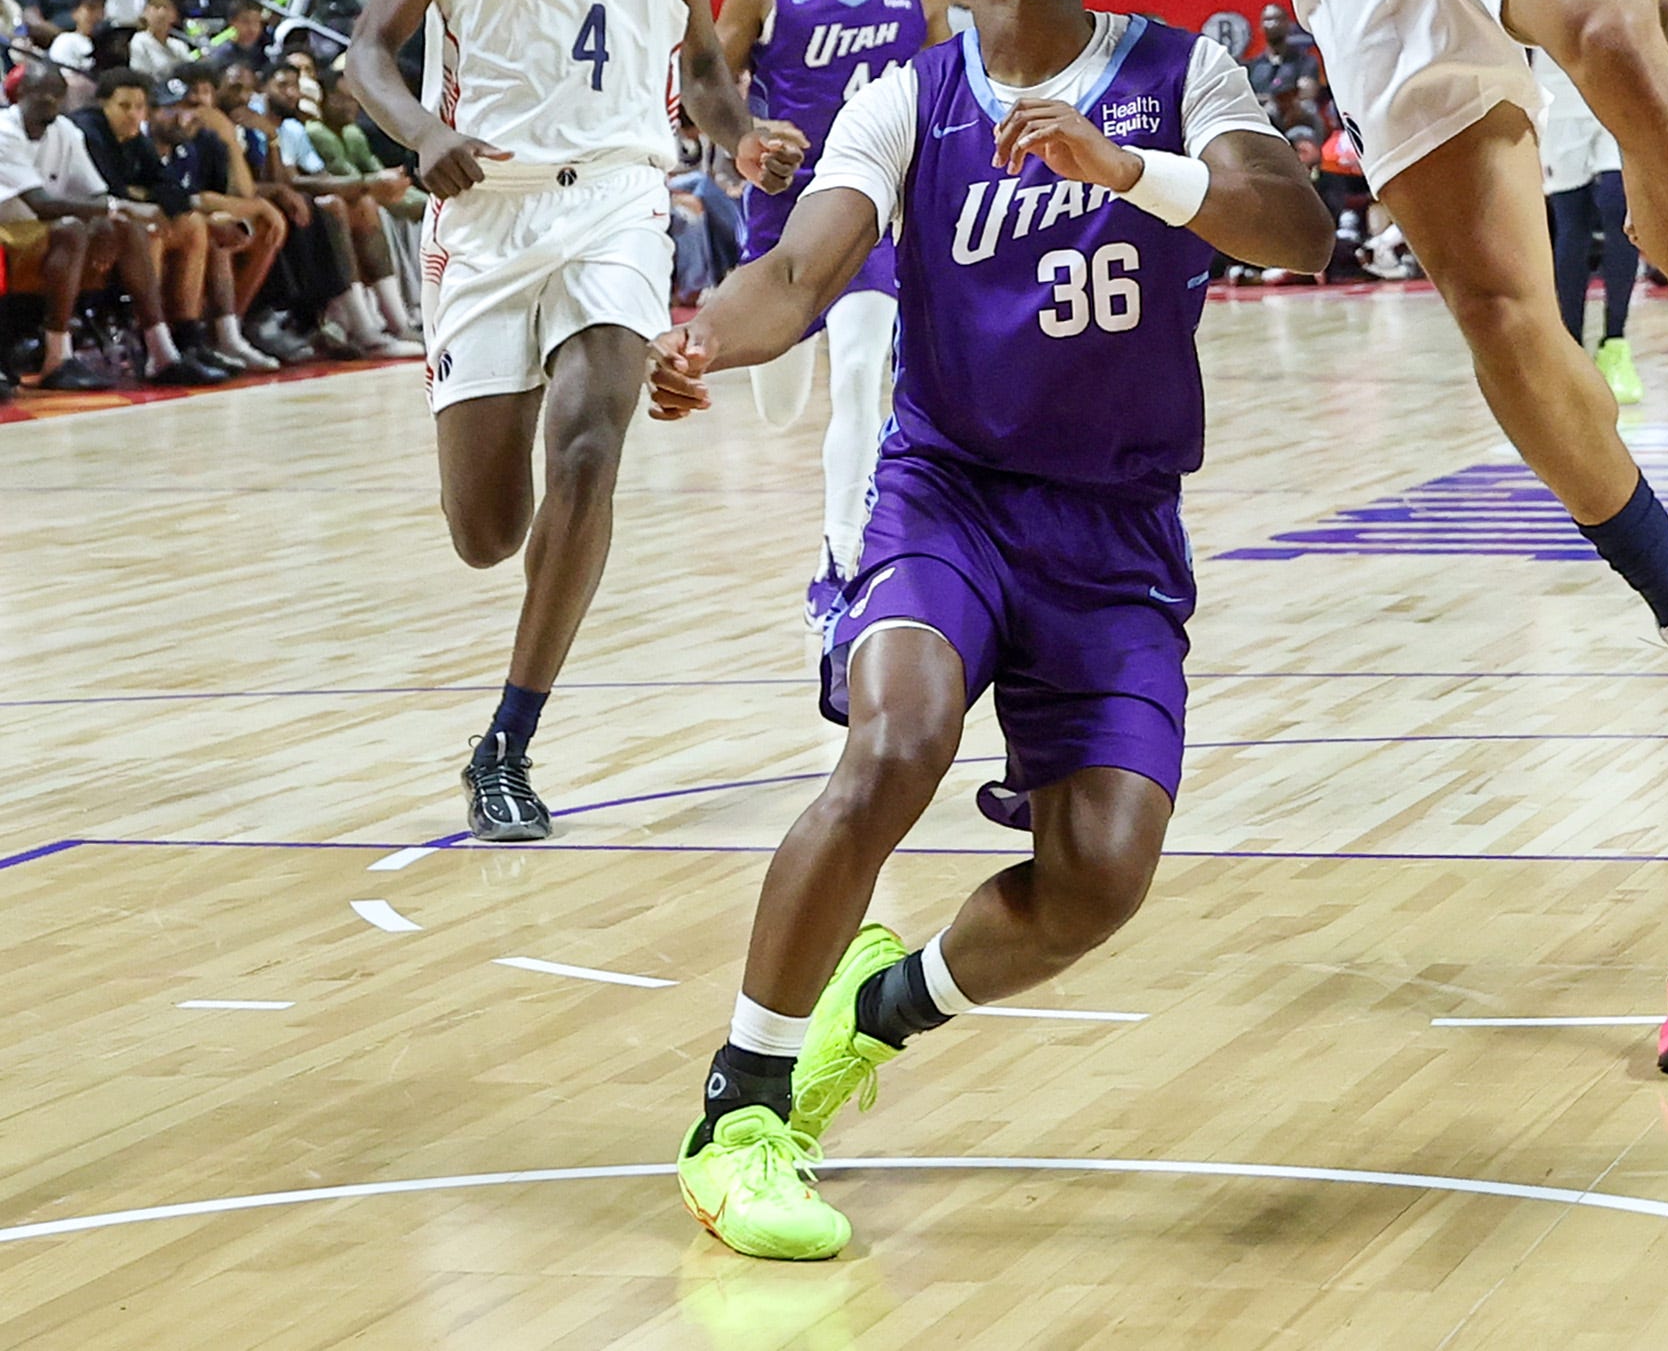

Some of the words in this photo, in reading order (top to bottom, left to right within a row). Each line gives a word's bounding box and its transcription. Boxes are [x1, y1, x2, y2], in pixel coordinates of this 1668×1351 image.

[572, 3, 610, 91] 4
[804, 22, 899, 68] UTAH
[1102, 96, 1160, 121] Health
[1103, 114, 1160, 137] Equity
[1037, 242, 1141, 338] 36
